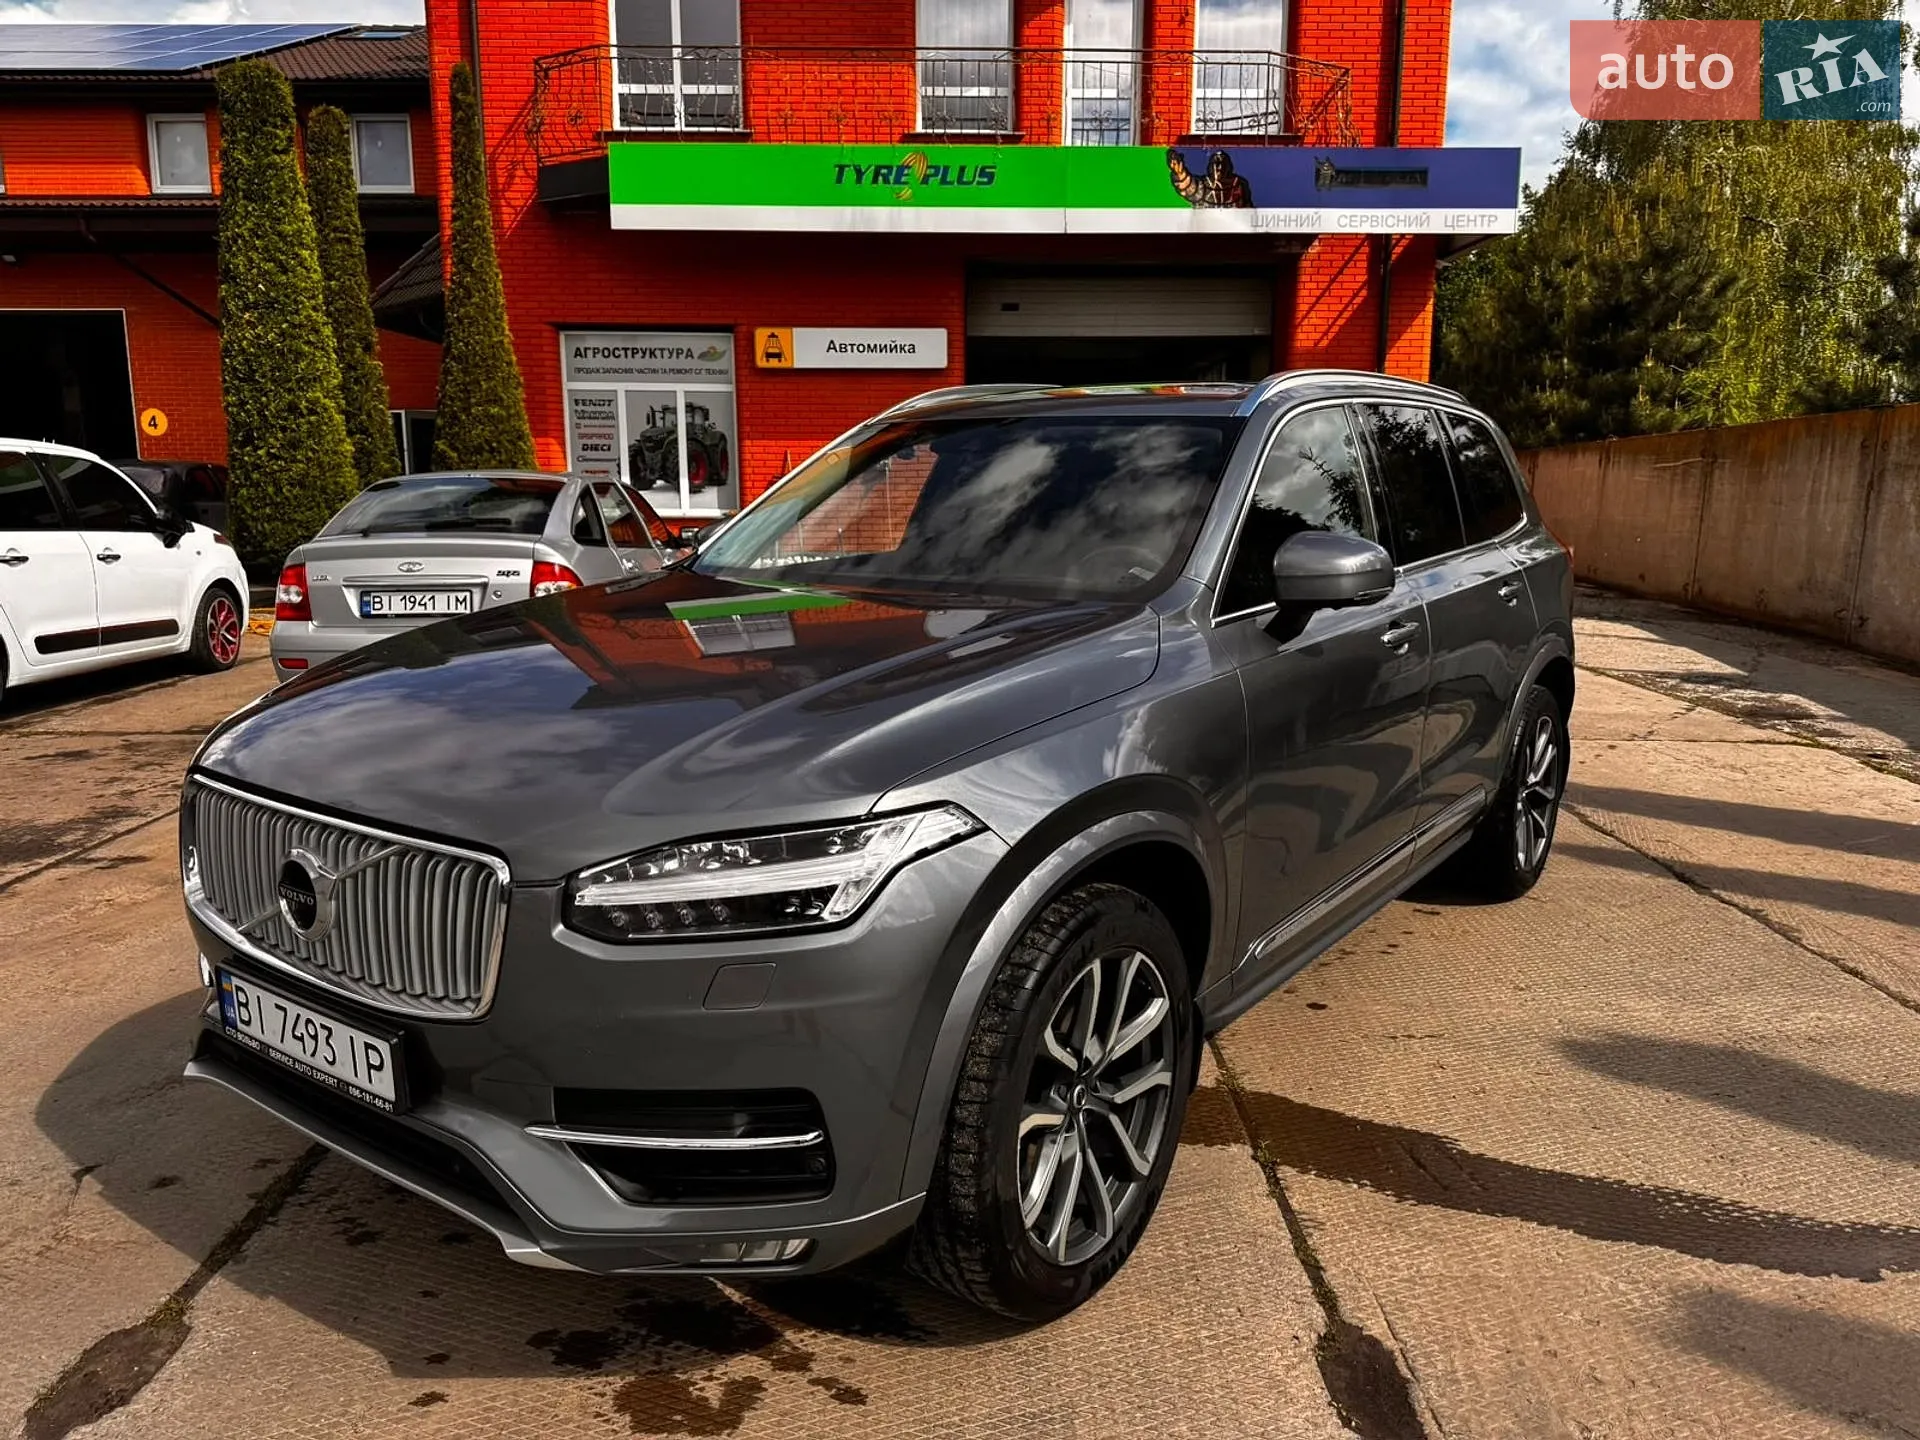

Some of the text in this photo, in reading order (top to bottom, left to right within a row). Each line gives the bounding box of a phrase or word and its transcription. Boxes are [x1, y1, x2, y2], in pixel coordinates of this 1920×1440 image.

[833, 163, 998, 187] TYRE PLUS
[1250, 211, 1498, 230] ШИННИЙ СЕРВІСНИЙ ЦЕНТР
[573, 346, 694, 360] АГРОСТРУКТУРА
[826, 339, 916, 354] Автомийка
[574, 398, 615, 407] FENDT
[148, 415, 159, 430] 4
[581, 443, 612, 452] DIECI
[372, 595, 468, 611] BI 1941 IM
[280, 886, 314, 906] VOLVO
[234, 984, 385, 1085] BI 7493 IP
[295, 1060, 312, 1076] AUTO
[313, 1069, 338, 1088] EXPERT
